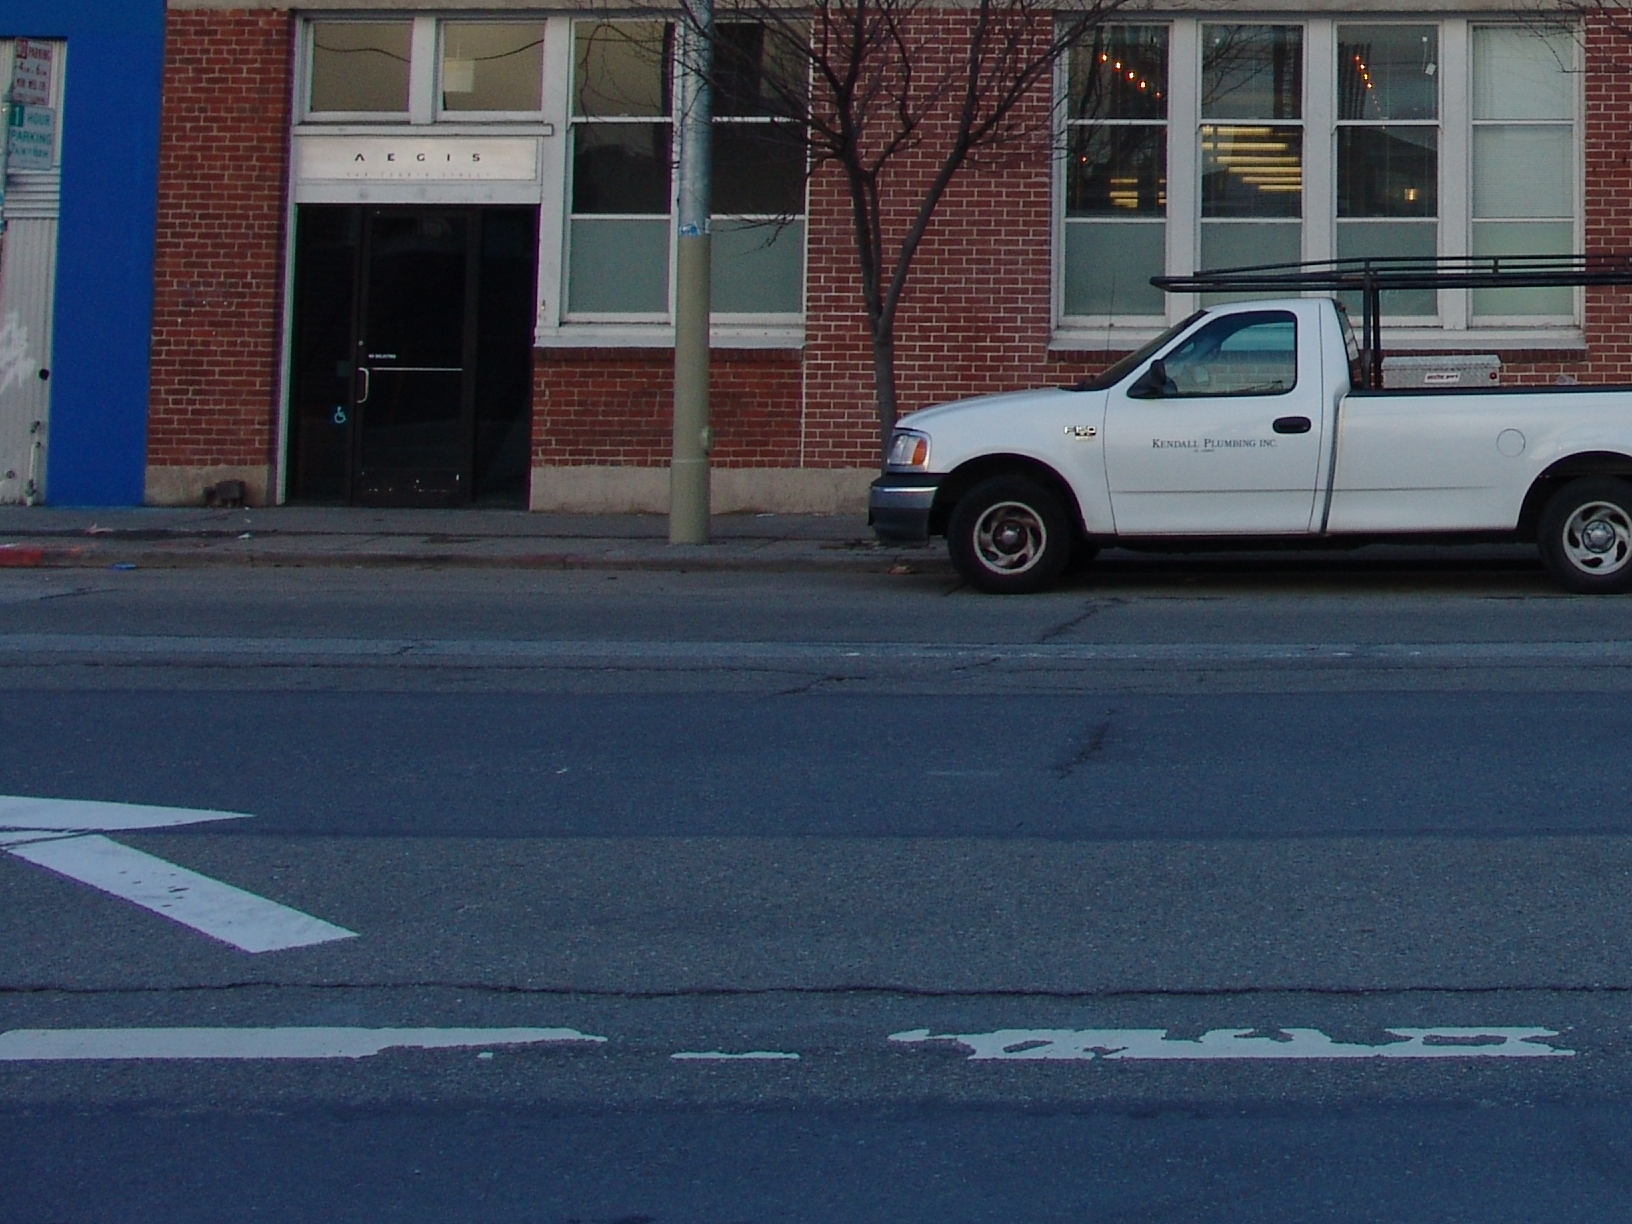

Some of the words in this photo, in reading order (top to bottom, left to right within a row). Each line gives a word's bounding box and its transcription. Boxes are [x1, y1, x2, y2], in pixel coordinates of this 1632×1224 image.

[27, 112, 51, 127] HOUR
[10, 130, 52, 146] PARKING
[354, 153, 481, 162] AEGIS
[1152, 438, 1199, 449] KENDALL
[1203, 438, 1256, 449] PLUMBING
